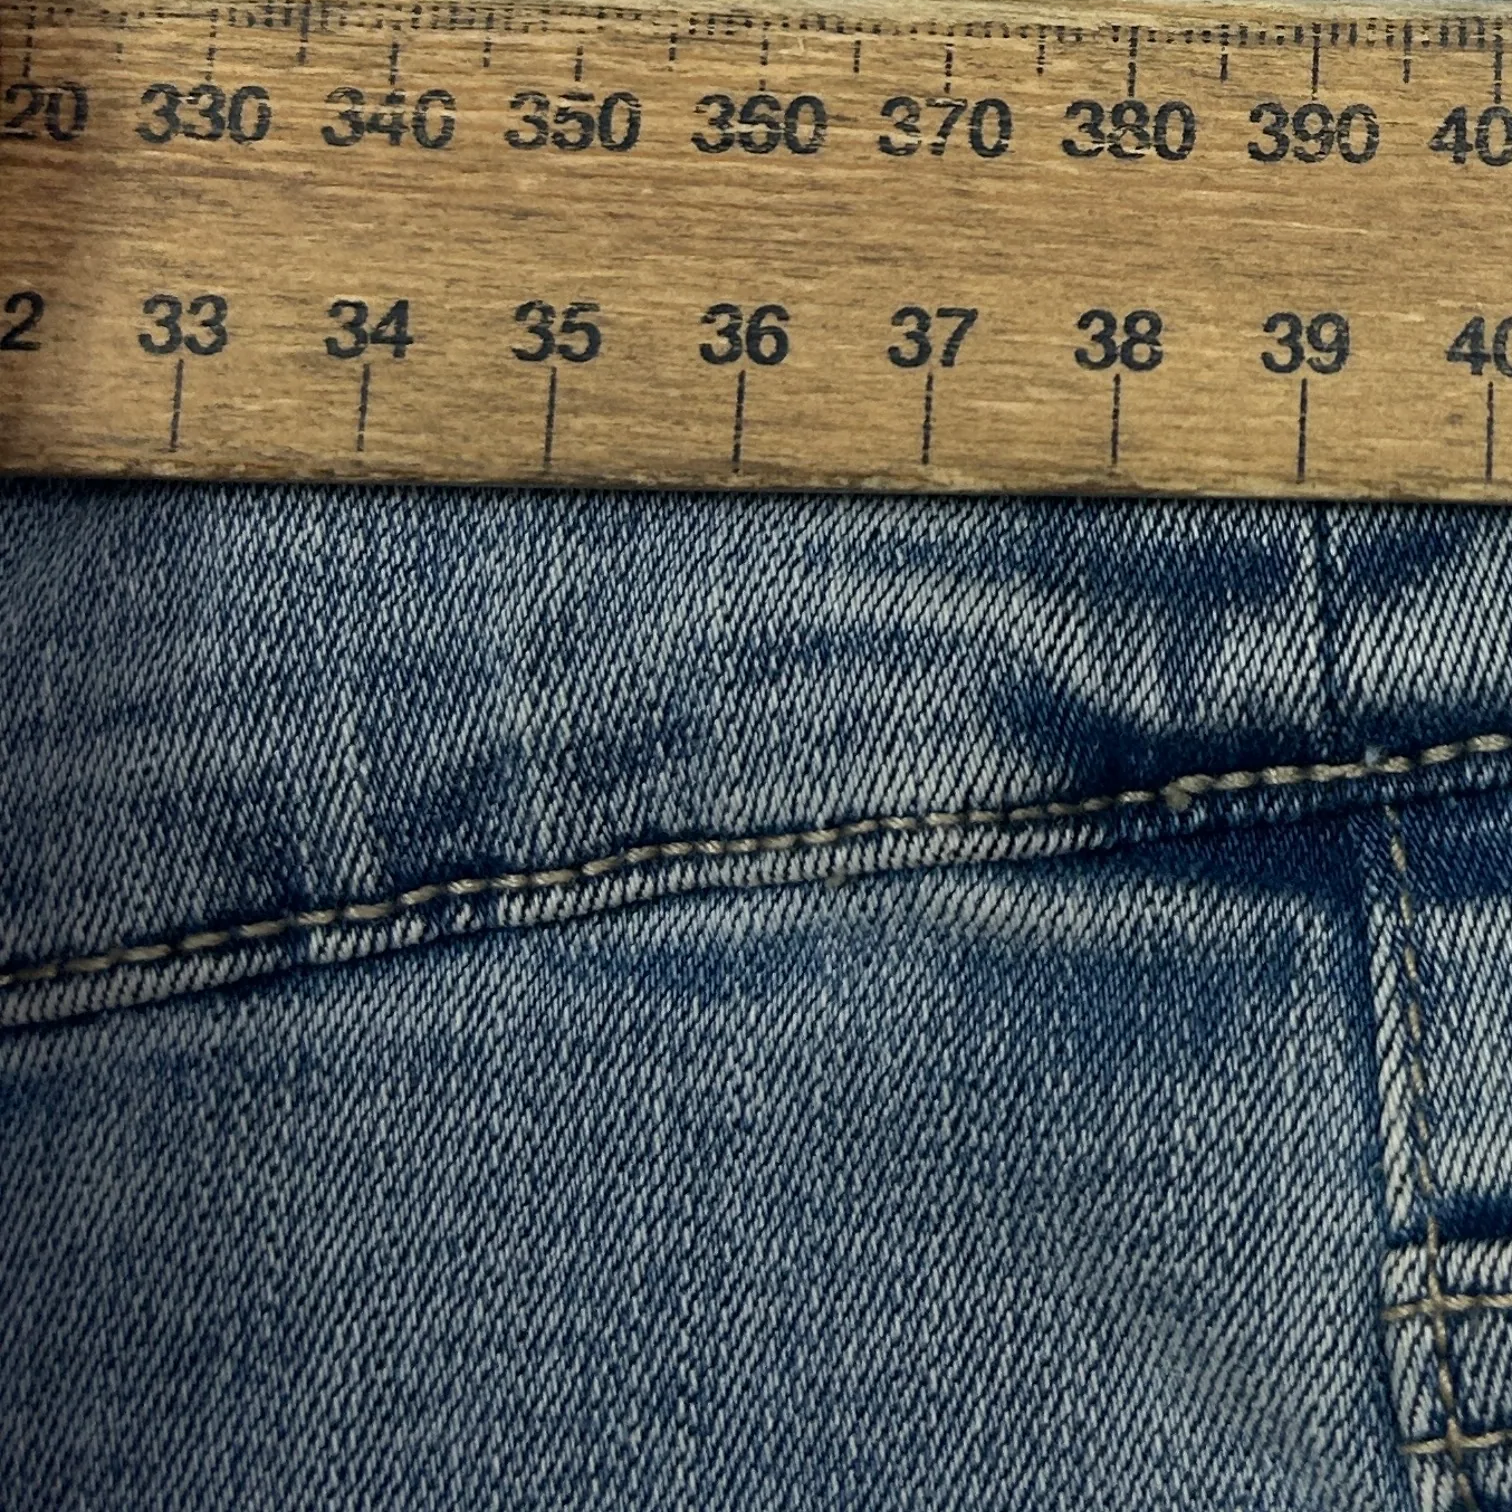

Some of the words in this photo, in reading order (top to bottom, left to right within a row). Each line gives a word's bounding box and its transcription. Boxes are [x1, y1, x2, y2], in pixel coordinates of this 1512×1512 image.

[136, 83, 272, 145] 330
[322, 87, 456, 149] 340
[504, 91, 642, 153] 350
[691, 93, 829, 155] 360
[878, 96, 1012, 158] 370
[1061, 99, 1196, 161] 380
[1247, 102, 1379, 164] 390
[138, 294, 228, 356] 33
[324, 298, 414, 359] 34
[510, 301, 602, 363] 35
[699, 303, 790, 365] 36
[887, 306, 979, 368] 37
[1073, 309, 1165, 372] 38
[1260, 311, 1352, 375] 39
